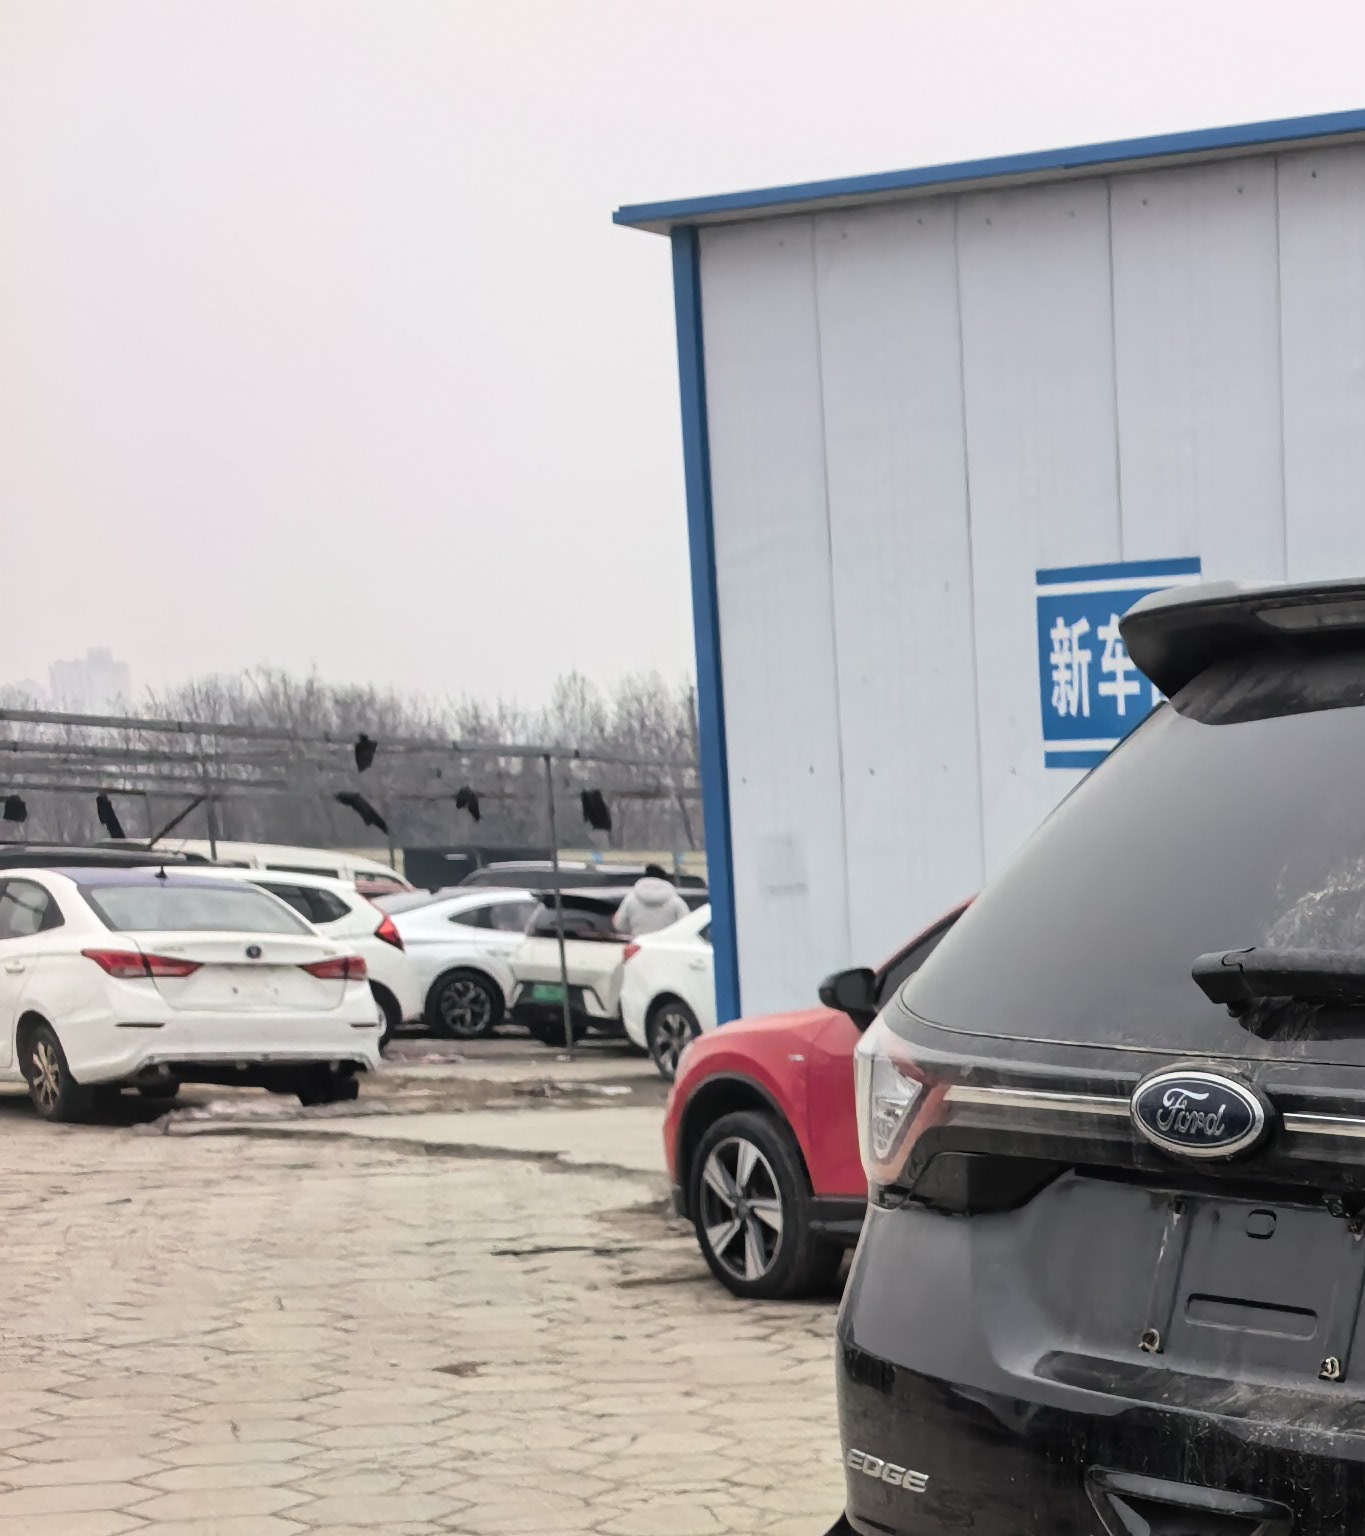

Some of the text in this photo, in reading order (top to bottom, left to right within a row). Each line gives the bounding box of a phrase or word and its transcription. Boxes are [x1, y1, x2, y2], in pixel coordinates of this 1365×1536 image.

[1050, 613, 1169, 718] 新车
[1156, 1088, 1226, 1136] Ford
[847, 1448, 930, 1493] EDGE
